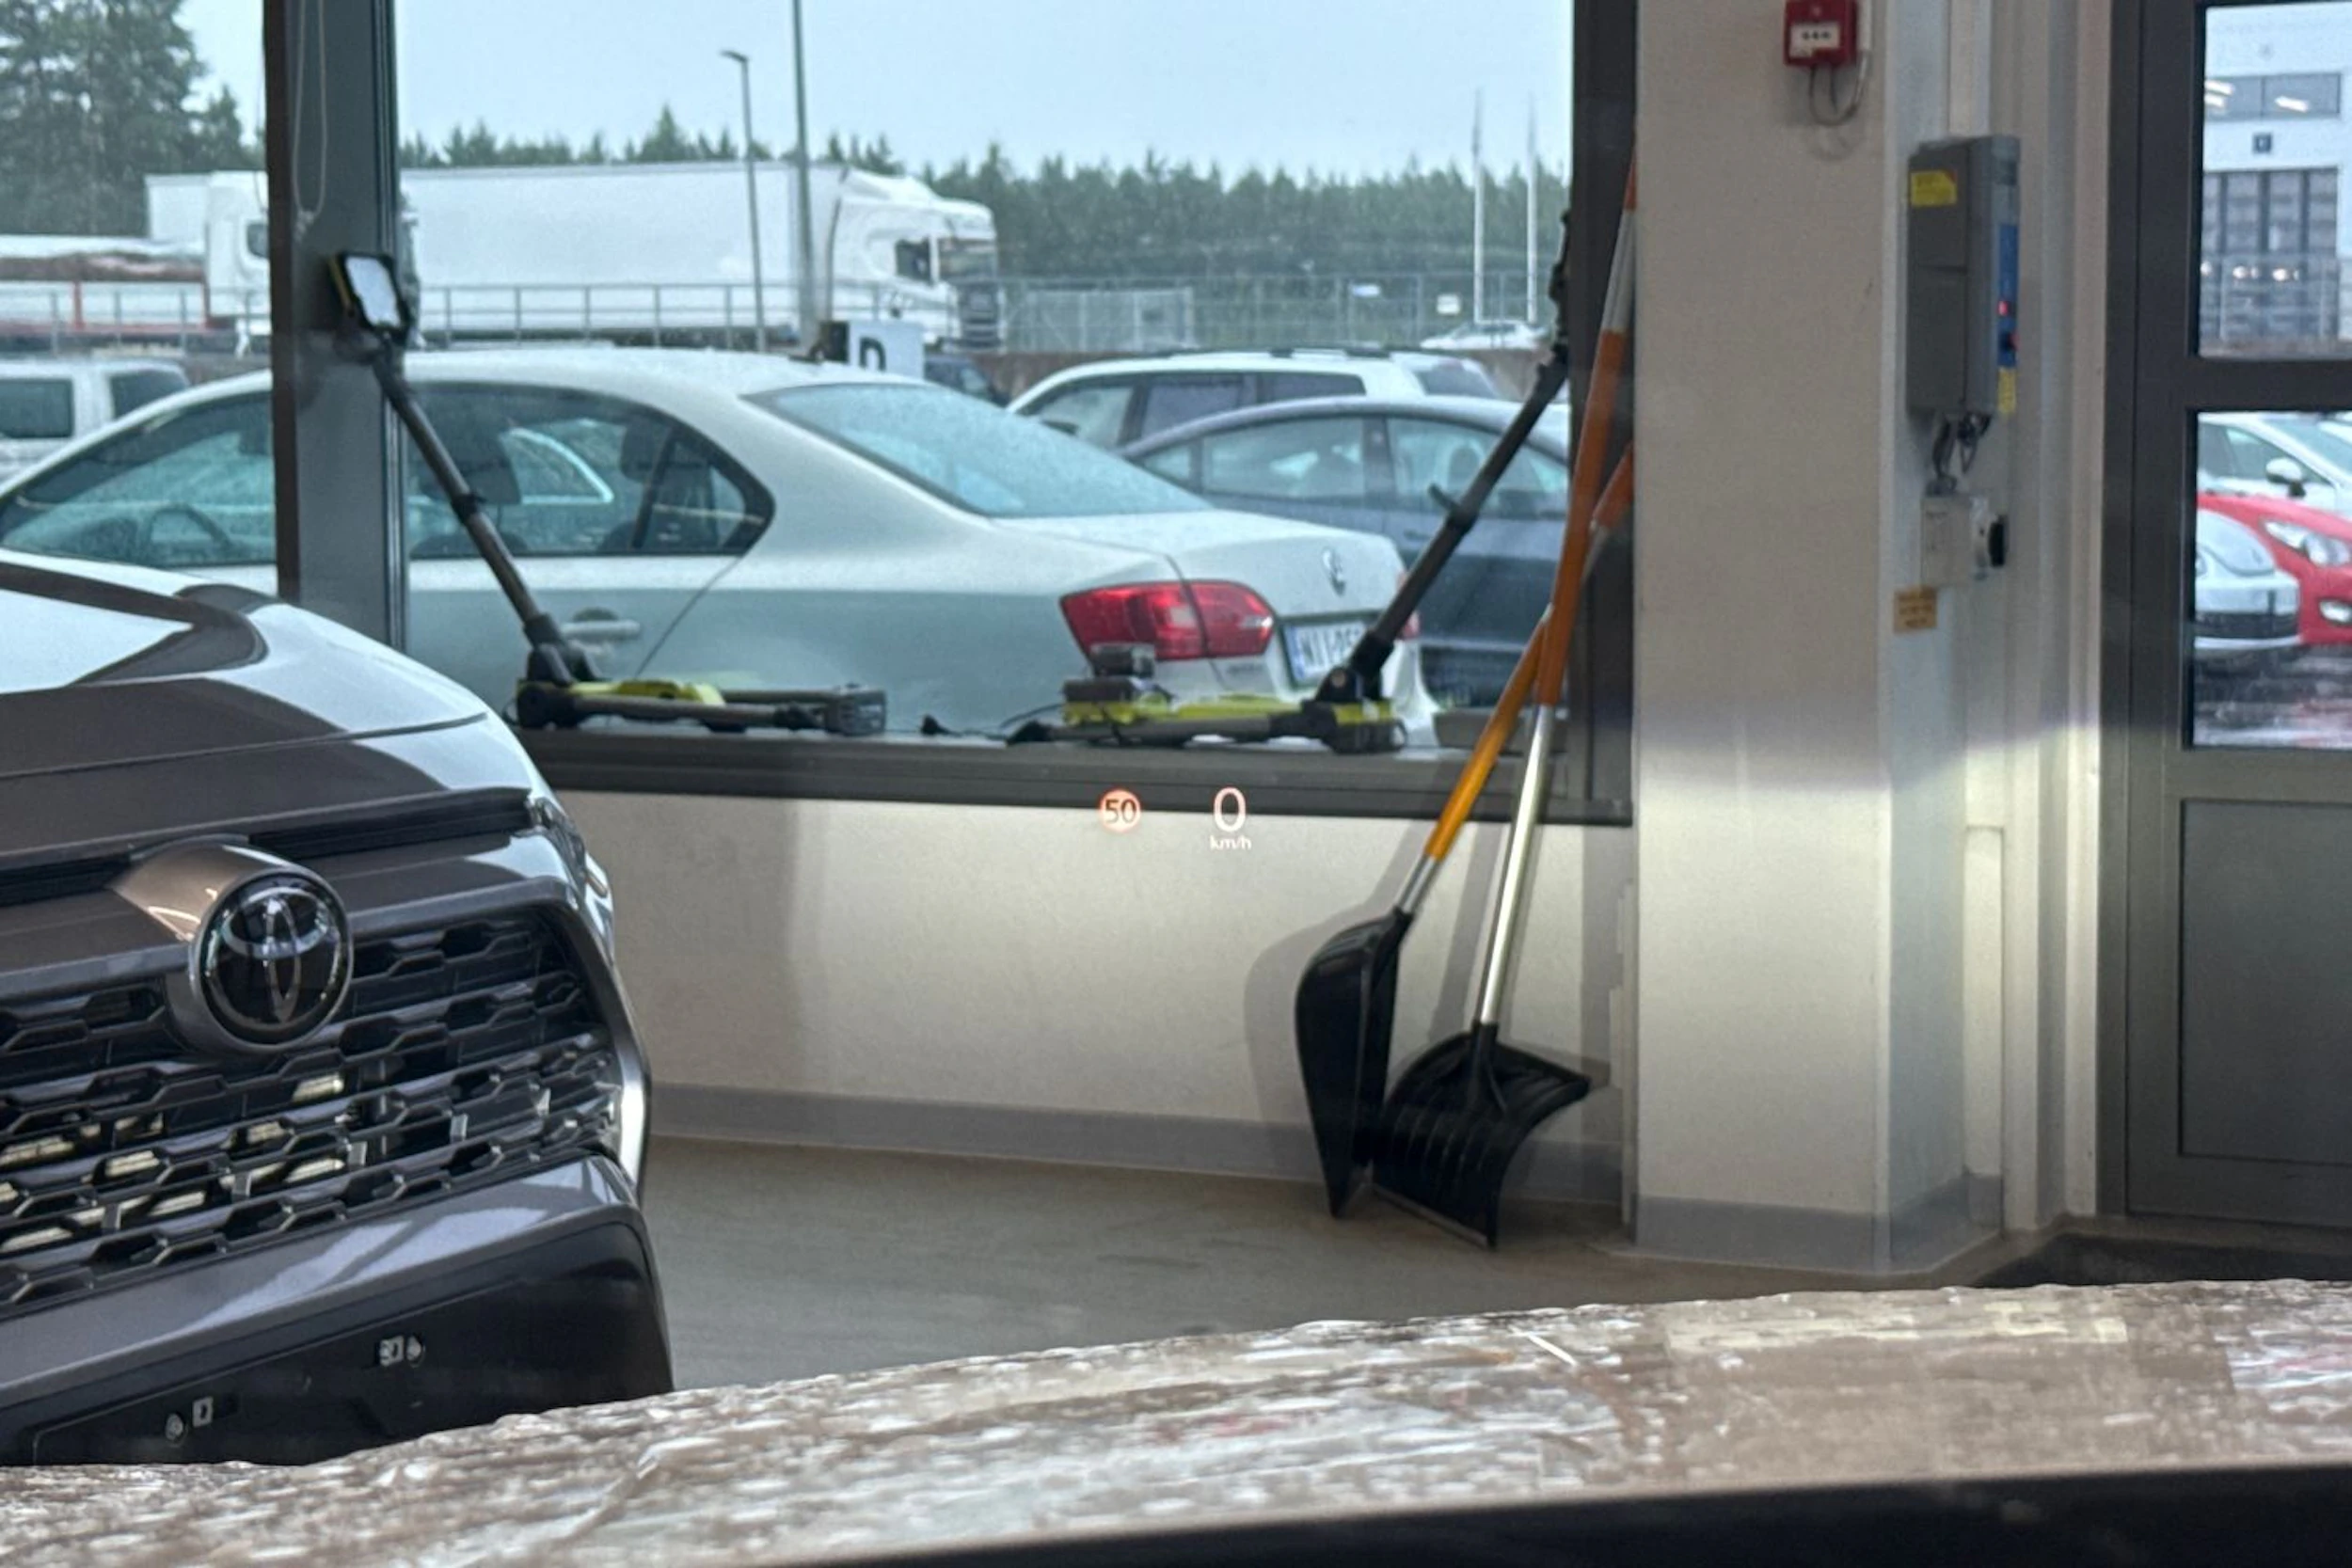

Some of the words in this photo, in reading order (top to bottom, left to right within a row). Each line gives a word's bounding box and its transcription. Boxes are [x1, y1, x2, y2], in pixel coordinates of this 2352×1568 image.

[1104, 798, 1137, 824] 50
[1214, 786, 1247, 832] 0
[1209, 835, 1252, 850] km/h
